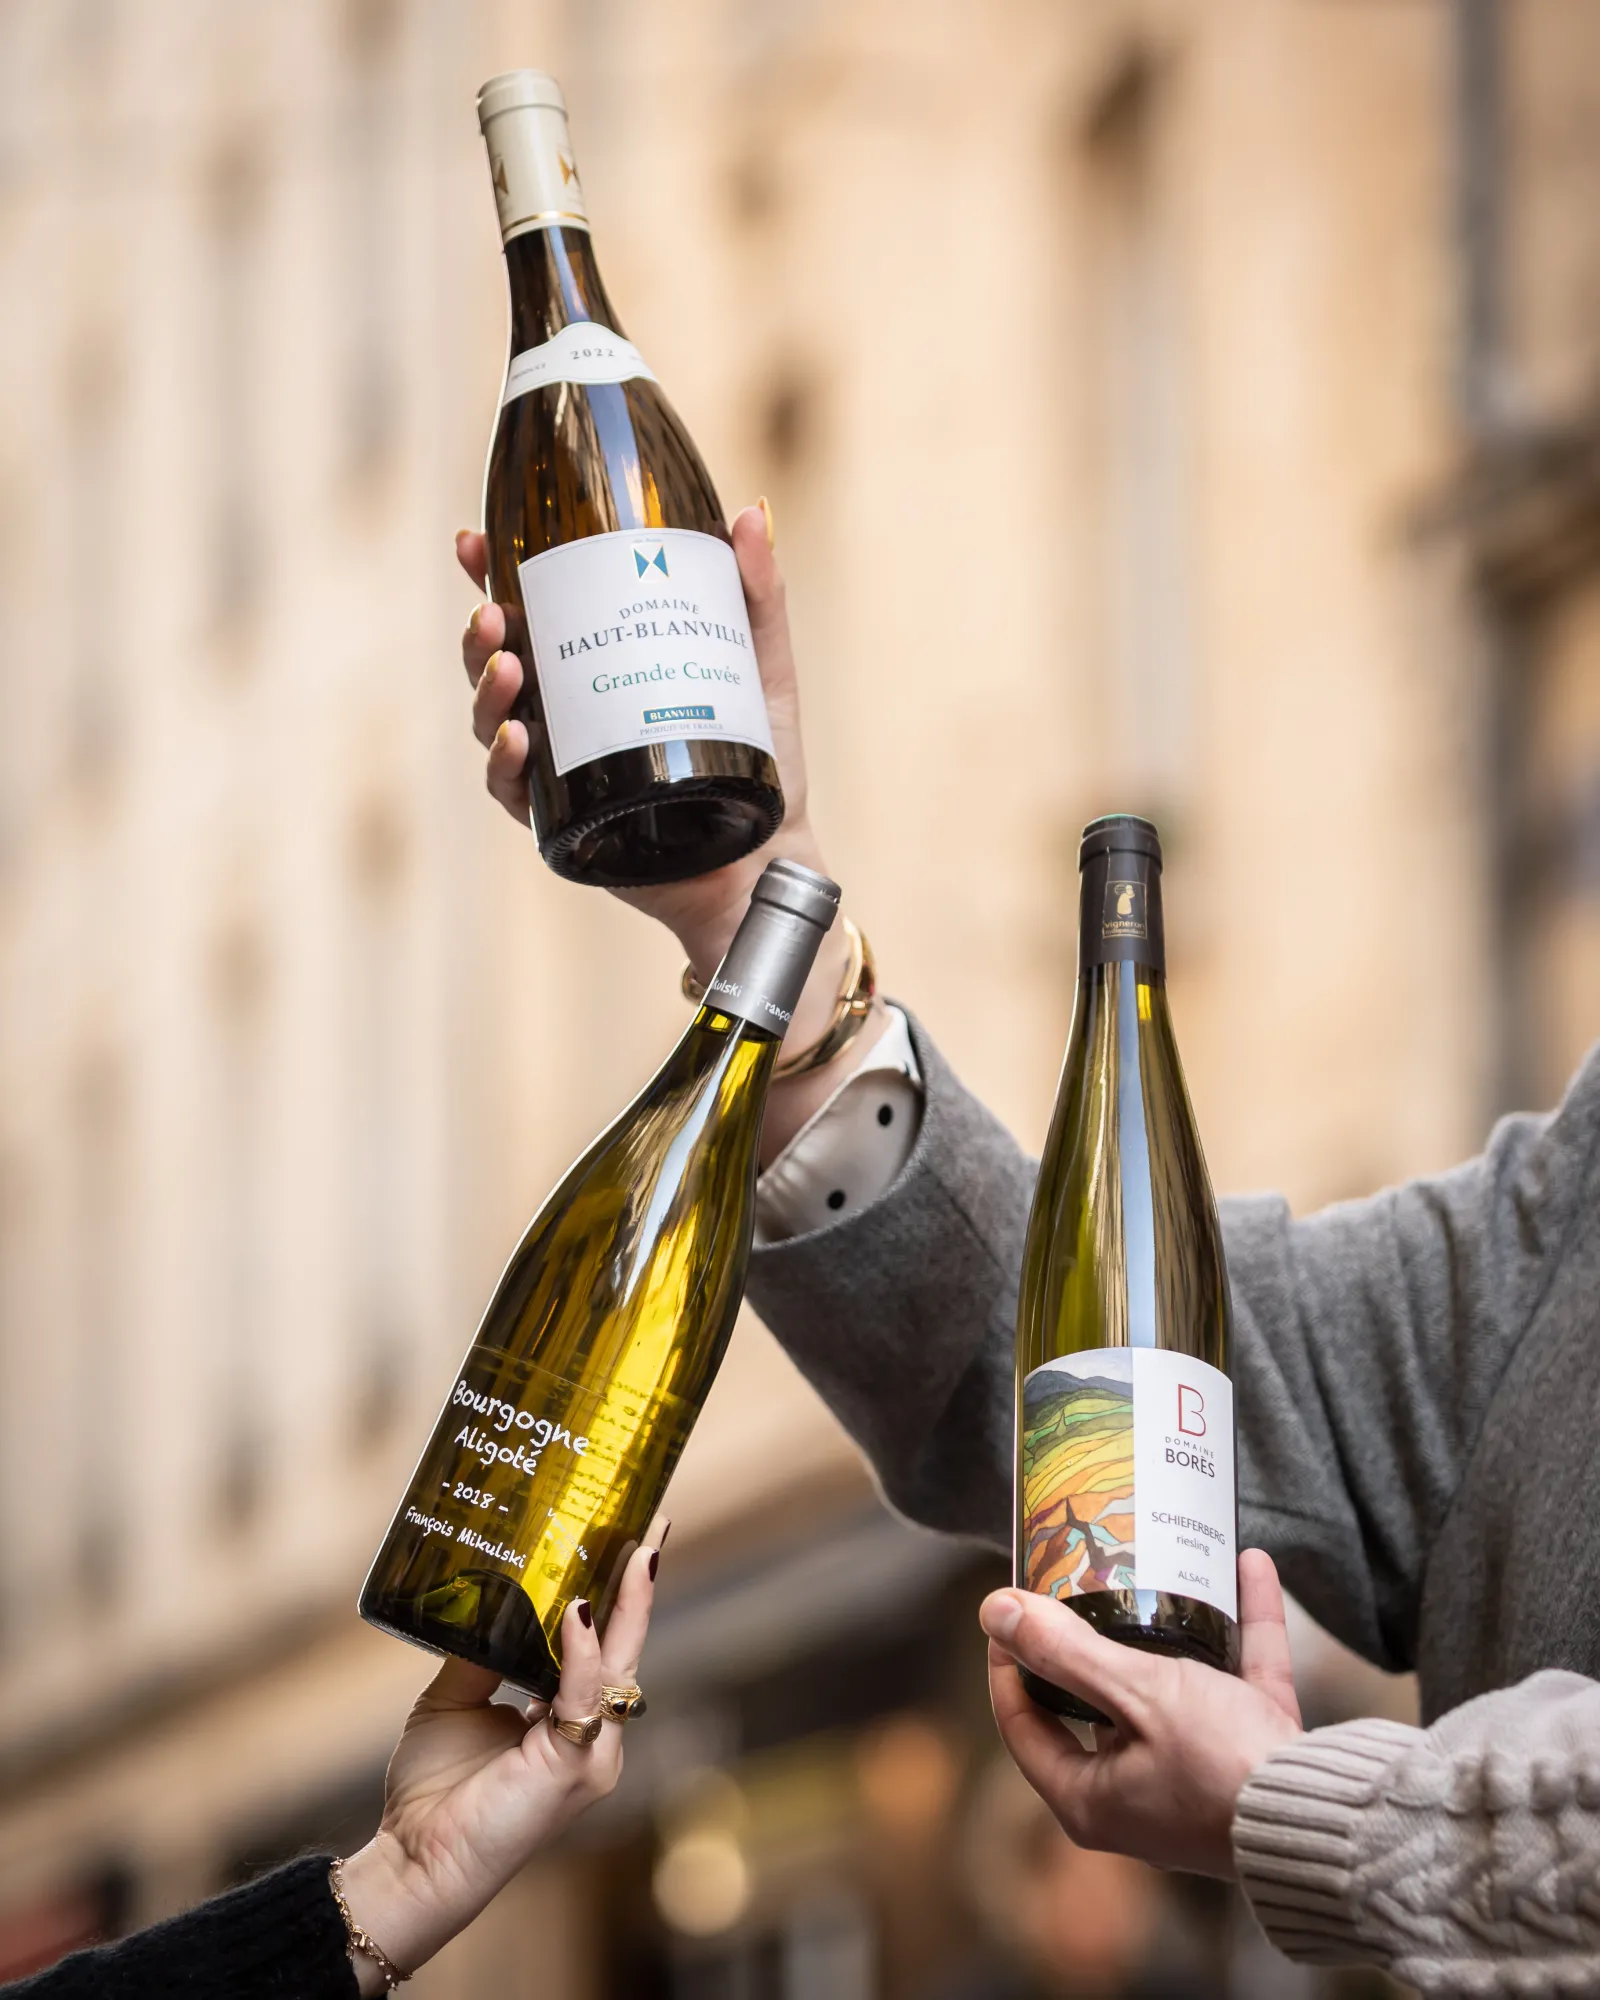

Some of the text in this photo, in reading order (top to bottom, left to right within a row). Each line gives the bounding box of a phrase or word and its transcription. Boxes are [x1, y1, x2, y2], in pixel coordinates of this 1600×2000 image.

[570, 348, 615, 360] 2022
[619, 598, 700, 620] DOMAINE
[558, 619, 749, 661] HAUT-BLANVILLE
[592, 661, 741, 693] Grande Cuvée
[650, 708, 709, 721] BLANVILLE
[693, 722, 724, 731] FRANCE
[453, 1379, 589, 1457] Bourgogne
[1178, 1383, 1207, 1437] B
[454, 1425, 543, 1476] Aligoté
[1165, 1436, 1215, 1459] DOMAINE
[1165, 1448, 1215, 1478] BORÈS
[452, 1481, 496, 1509] 2018
[404, 1506, 454, 1537] François
[456, 1527, 527, 1569] Mikulski
[1151, 1511, 1226, 1546] SCHIEFERBERG
[1176, 1534, 1210, 1557] riesling
[1178, 1569, 1210, 1589] ALSACE
